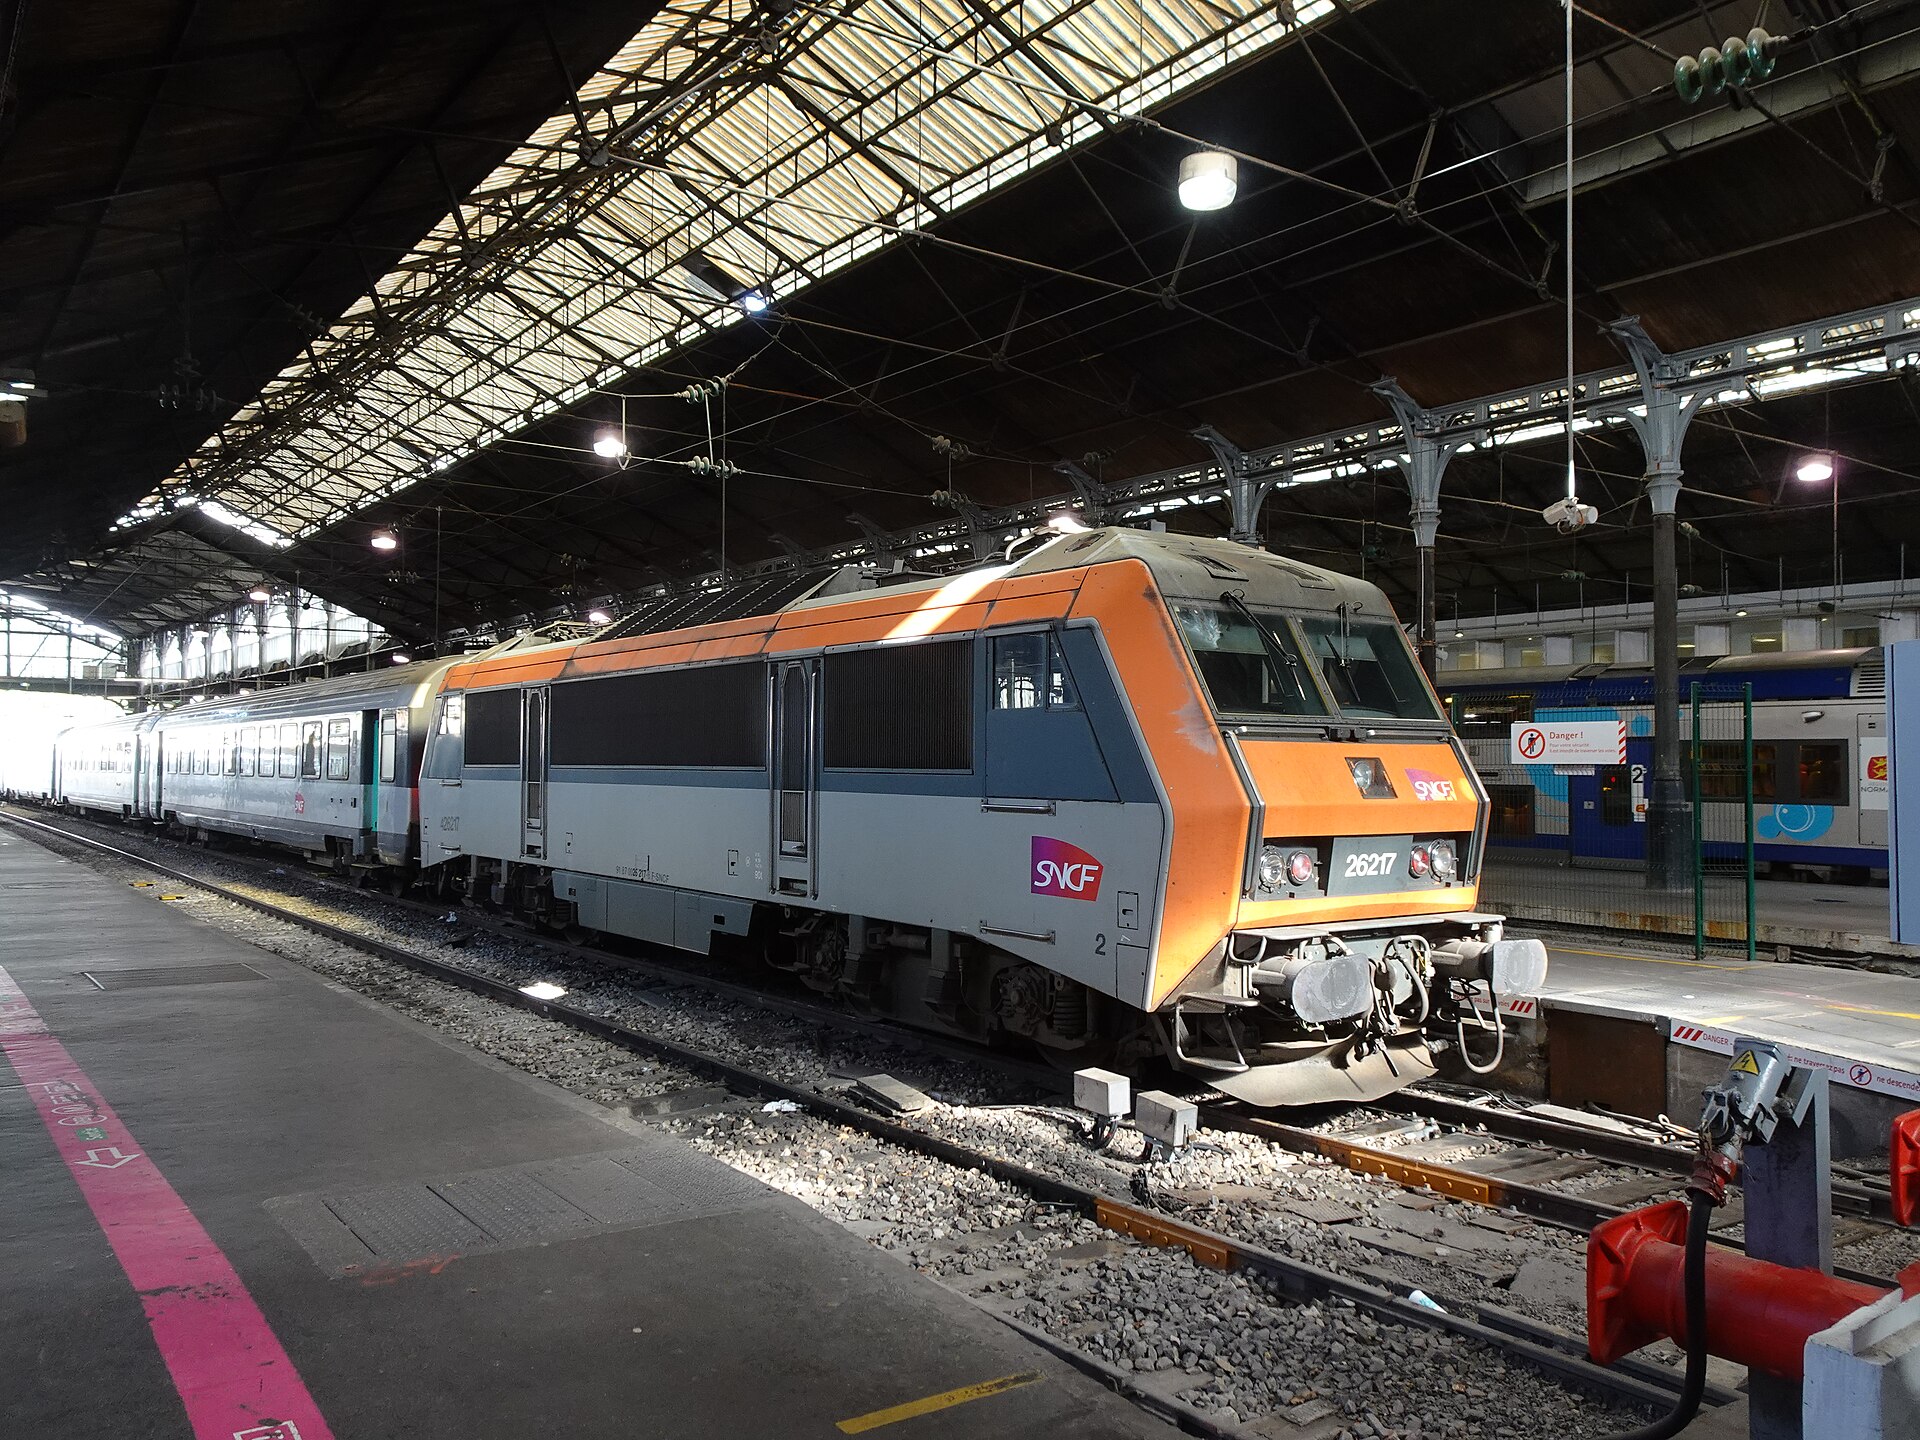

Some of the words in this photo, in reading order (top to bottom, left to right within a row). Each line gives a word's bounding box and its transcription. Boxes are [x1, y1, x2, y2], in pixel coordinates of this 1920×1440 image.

[1549, 731, 1578, 741] Danger
[1632, 766, 1643, 783] 2
[1414, 780, 1451, 798] SNCF
[1344, 852, 1397, 877] 26217
[1034, 860, 1099, 892] SNCF
[1095, 933, 1106, 956] 2
[1702, 1033, 1729, 1046] DANGER
[1833, 1066, 1845, 1075] pas
